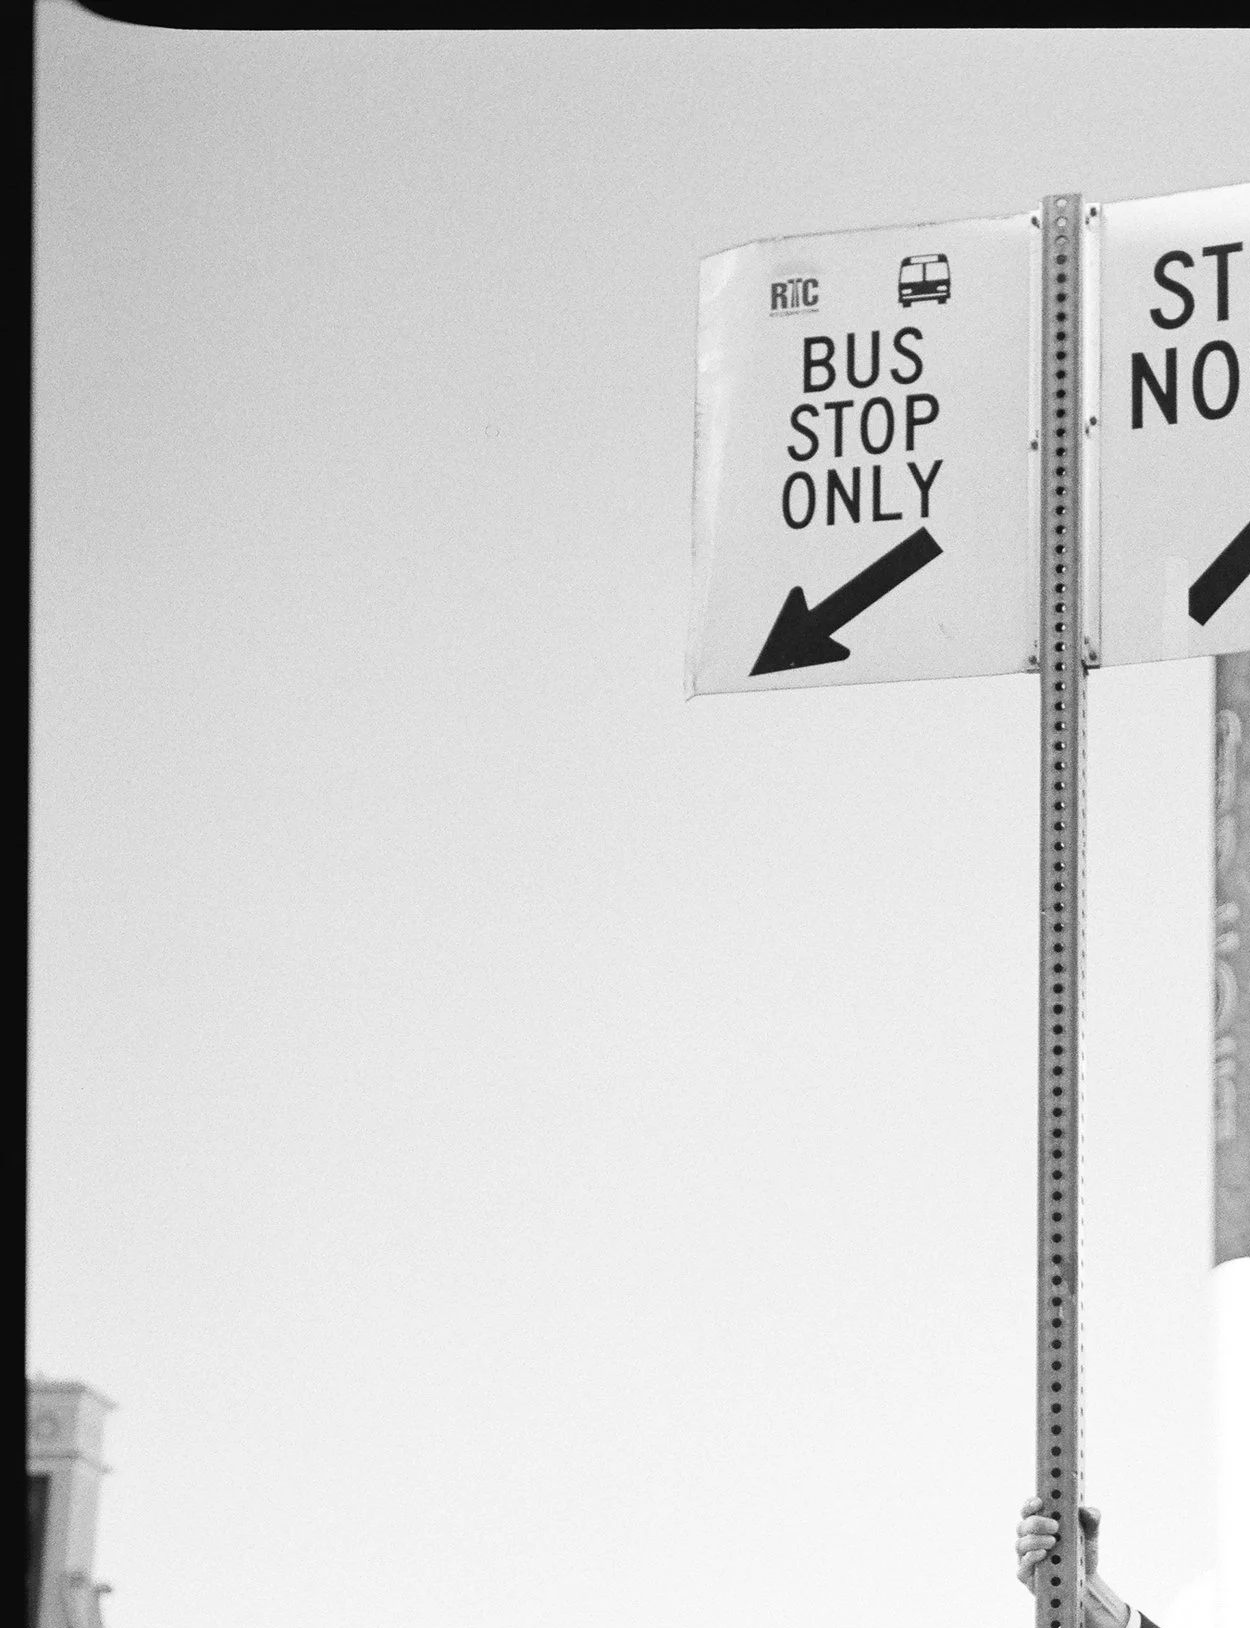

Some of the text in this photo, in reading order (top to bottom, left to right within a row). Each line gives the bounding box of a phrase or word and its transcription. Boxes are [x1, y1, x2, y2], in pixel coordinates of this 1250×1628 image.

[771, 278, 819, 310] RTC
[803, 326, 923, 394] BUS
[787, 393, 940, 462] STOP
[782, 459, 944, 530] ONLY
